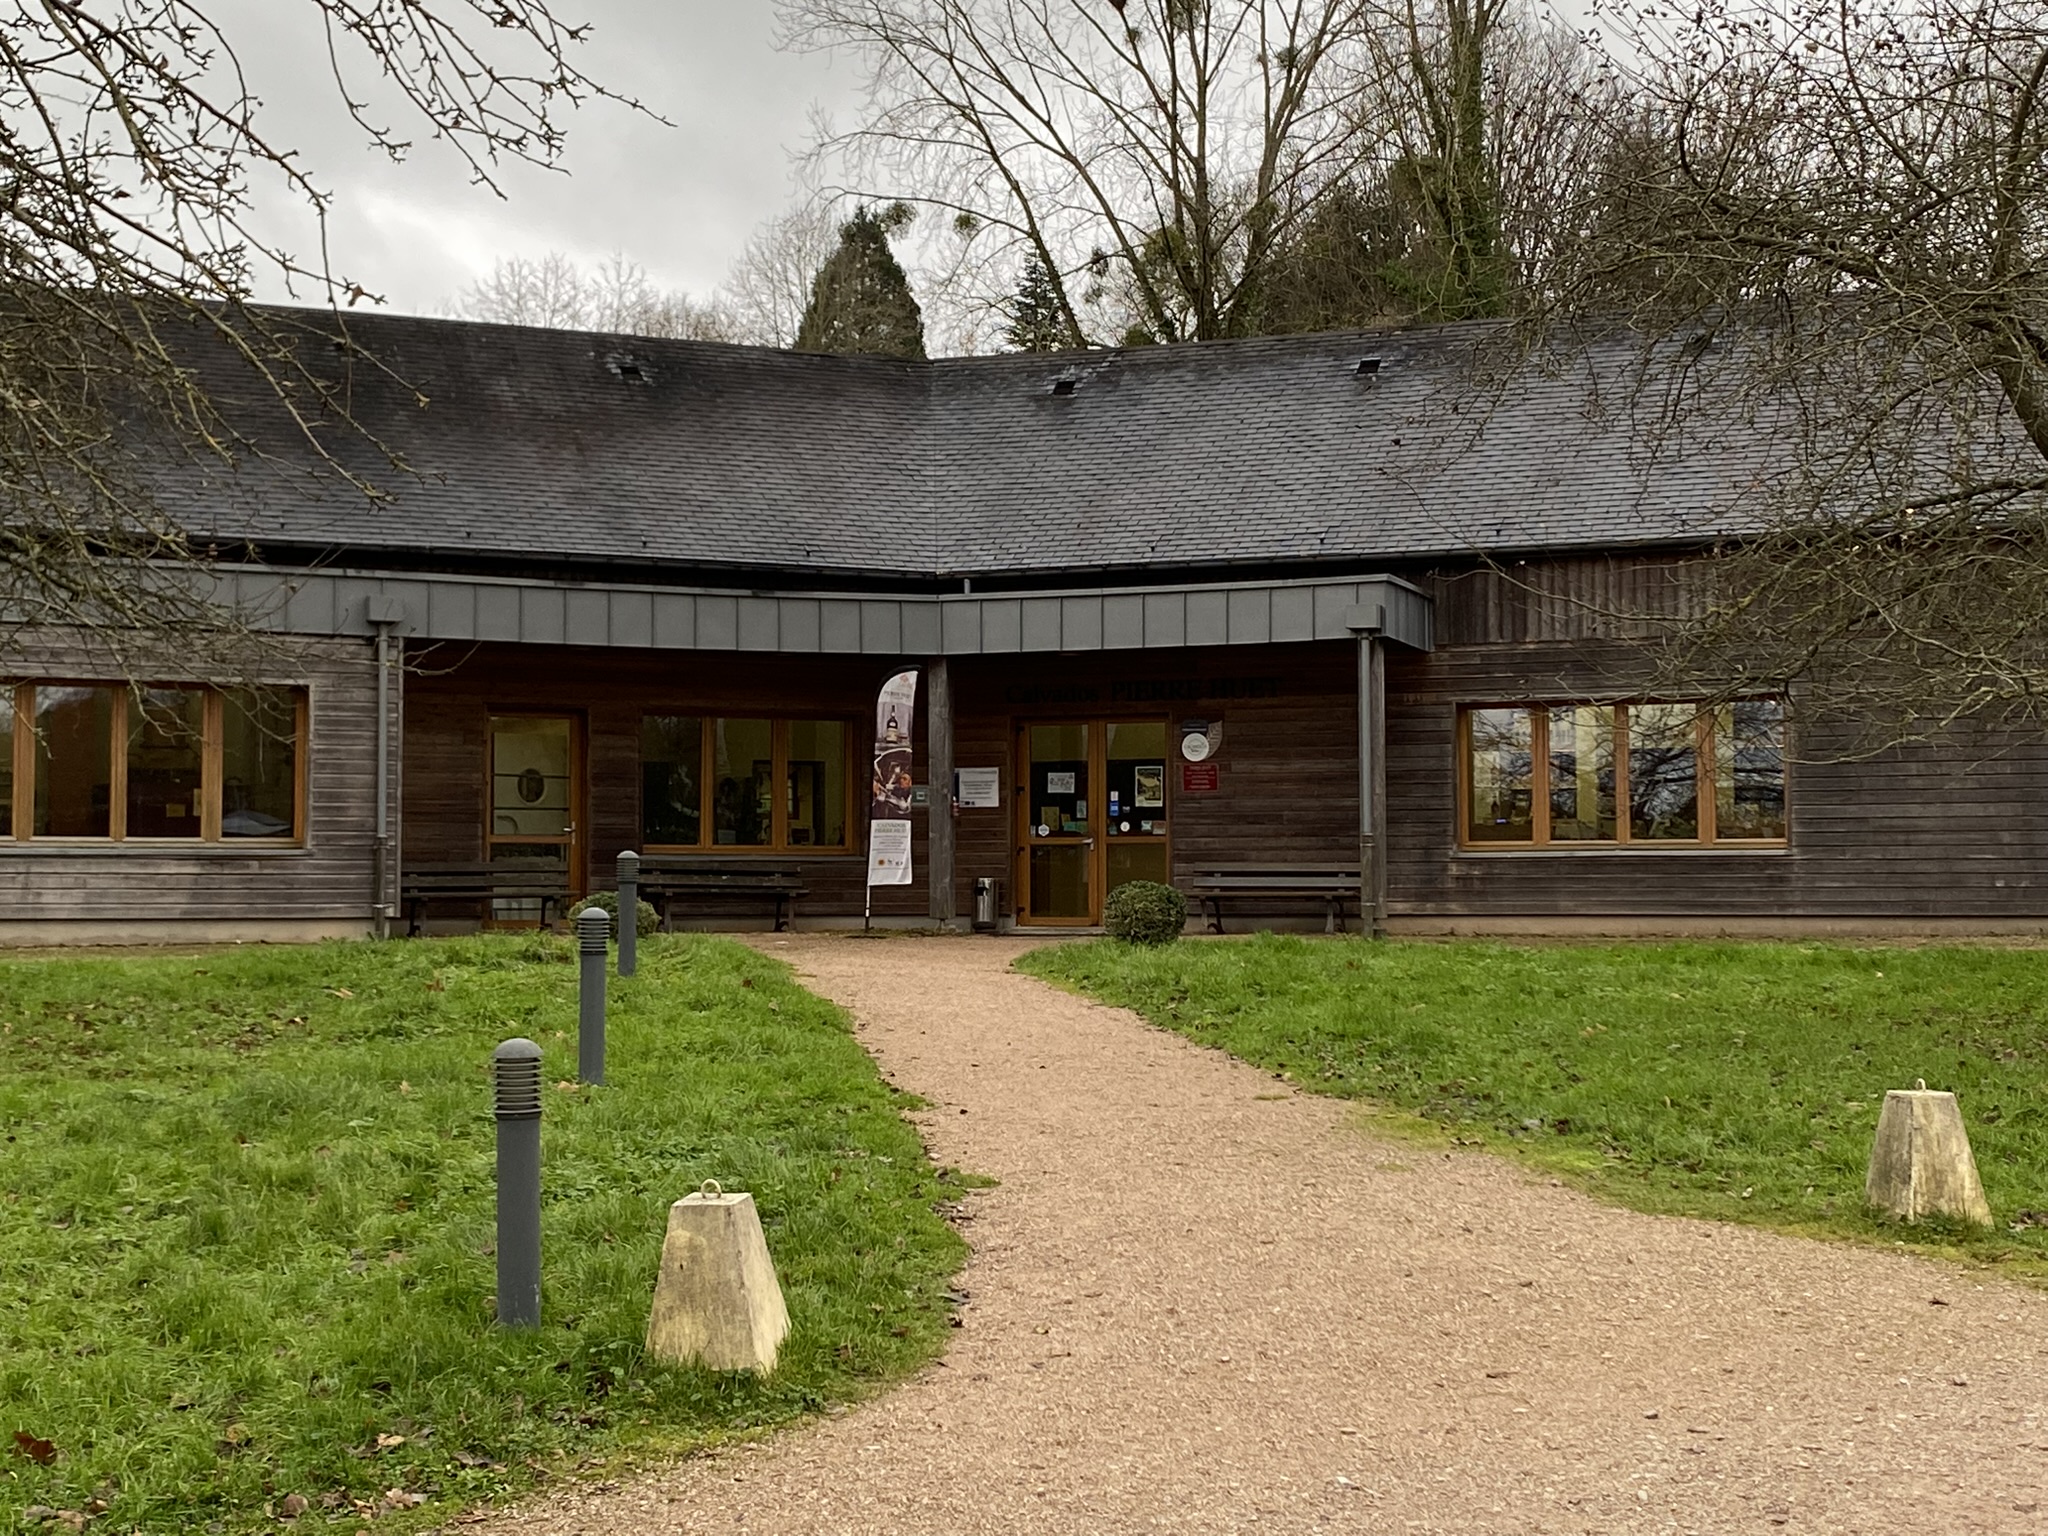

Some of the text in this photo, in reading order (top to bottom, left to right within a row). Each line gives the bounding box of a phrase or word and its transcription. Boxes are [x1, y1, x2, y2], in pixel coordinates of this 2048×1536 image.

[1006, 677, 1282, 703] Calvados PIERRE HUET
